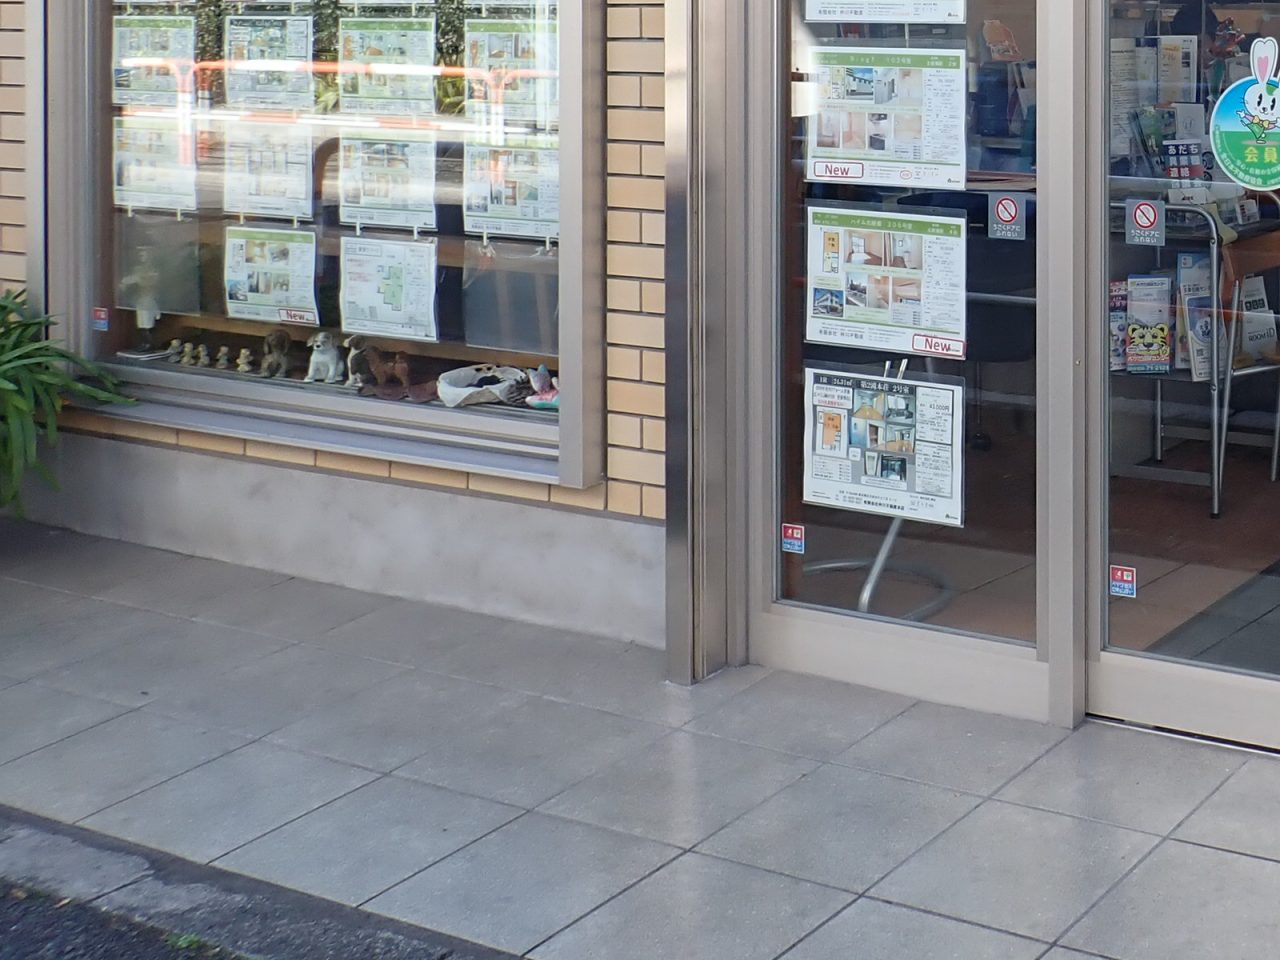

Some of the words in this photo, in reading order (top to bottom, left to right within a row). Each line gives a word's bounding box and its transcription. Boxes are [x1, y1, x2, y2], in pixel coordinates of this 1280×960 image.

[1244, 145, 1278, 163] 会員
[824, 163, 850, 176] New
[286, 310, 305, 320] New
[924, 337, 951, 352] New
